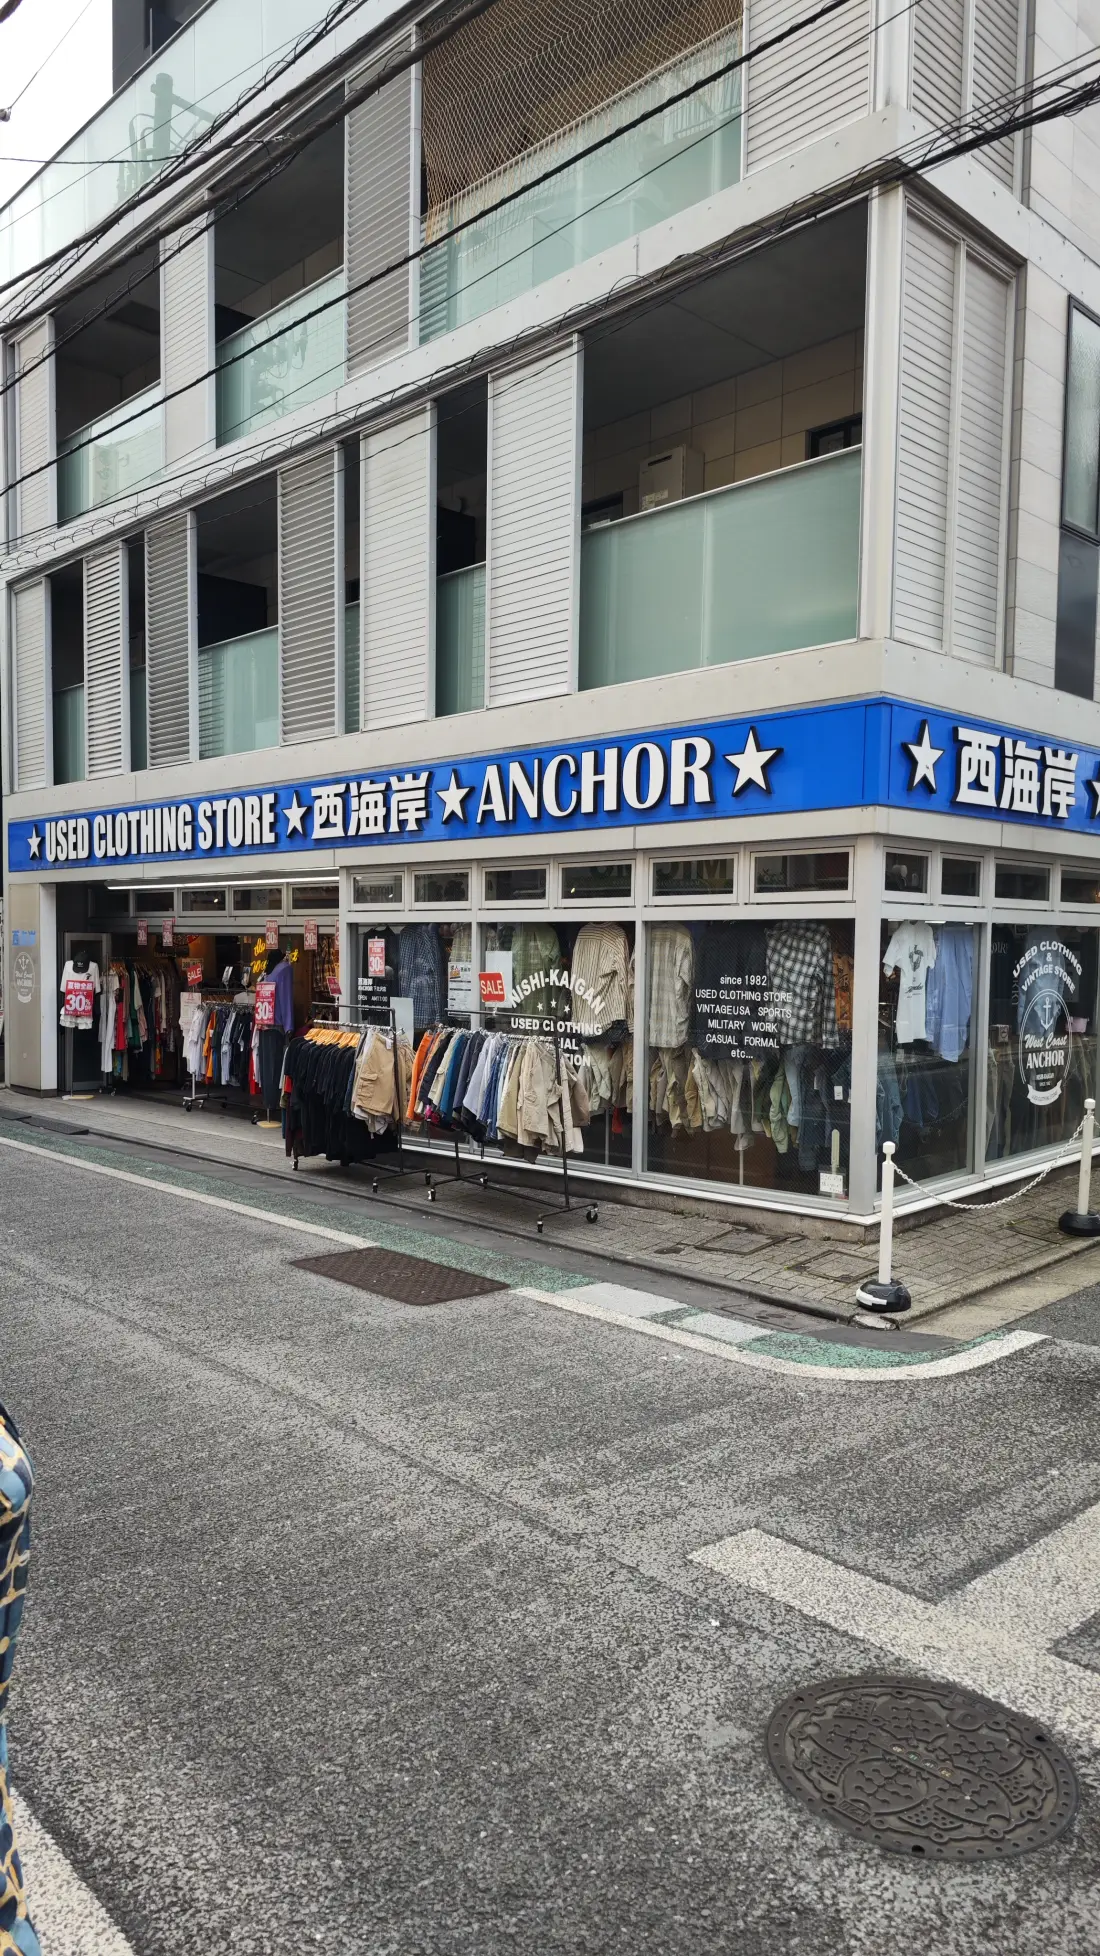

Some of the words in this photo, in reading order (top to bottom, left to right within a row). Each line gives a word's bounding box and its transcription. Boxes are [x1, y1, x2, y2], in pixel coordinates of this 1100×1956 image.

[476, 737, 713, 824] ANCHOR
[956, 726, 1079, 818] 西海岸
[311, 771, 431, 839] 西海岸
[45, 818, 89, 862] USED
[94, 804, 193, 858] CLOTHING
[198, 793, 276, 850] STORE
[1012, 945, 1038, 978] USED
[1040, 940, 1082, 976] CLOTHING
[1046, 952, 1053, 962] &
[187, 967, 202, 982] SALE
[720, 975, 742, 985] since
[745, 975, 767, 986] 1982
[1021, 964, 1053, 992] VINTAGE
[1054, 965, 1075, 994] STORE
[480, 980, 504, 995] SALE
[511, 969, 606, 1015] NISHI-KAIGAN
[696, 989, 717, 999] USED
[719, 990, 761, 1001] CLOTHING
[763, 992, 793, 1002] STORE
[697, 1004, 750, 1016] VINTAGEUSA
[758, 1007, 792, 1018] SPORTS
[511, 1018, 540, 1030] USED
[708, 1019, 745, 1030] MILITARY
[751, 1021, 778, 1033] WORK
[706, 1034, 738, 1045] CASUAL
[744, 1036, 780, 1048] FORMAL
[1024, 1033, 1045, 1050] West
[1045, 1031, 1068, 1050] Coast
[1026, 1050, 1065, 1069] ANCHOR
